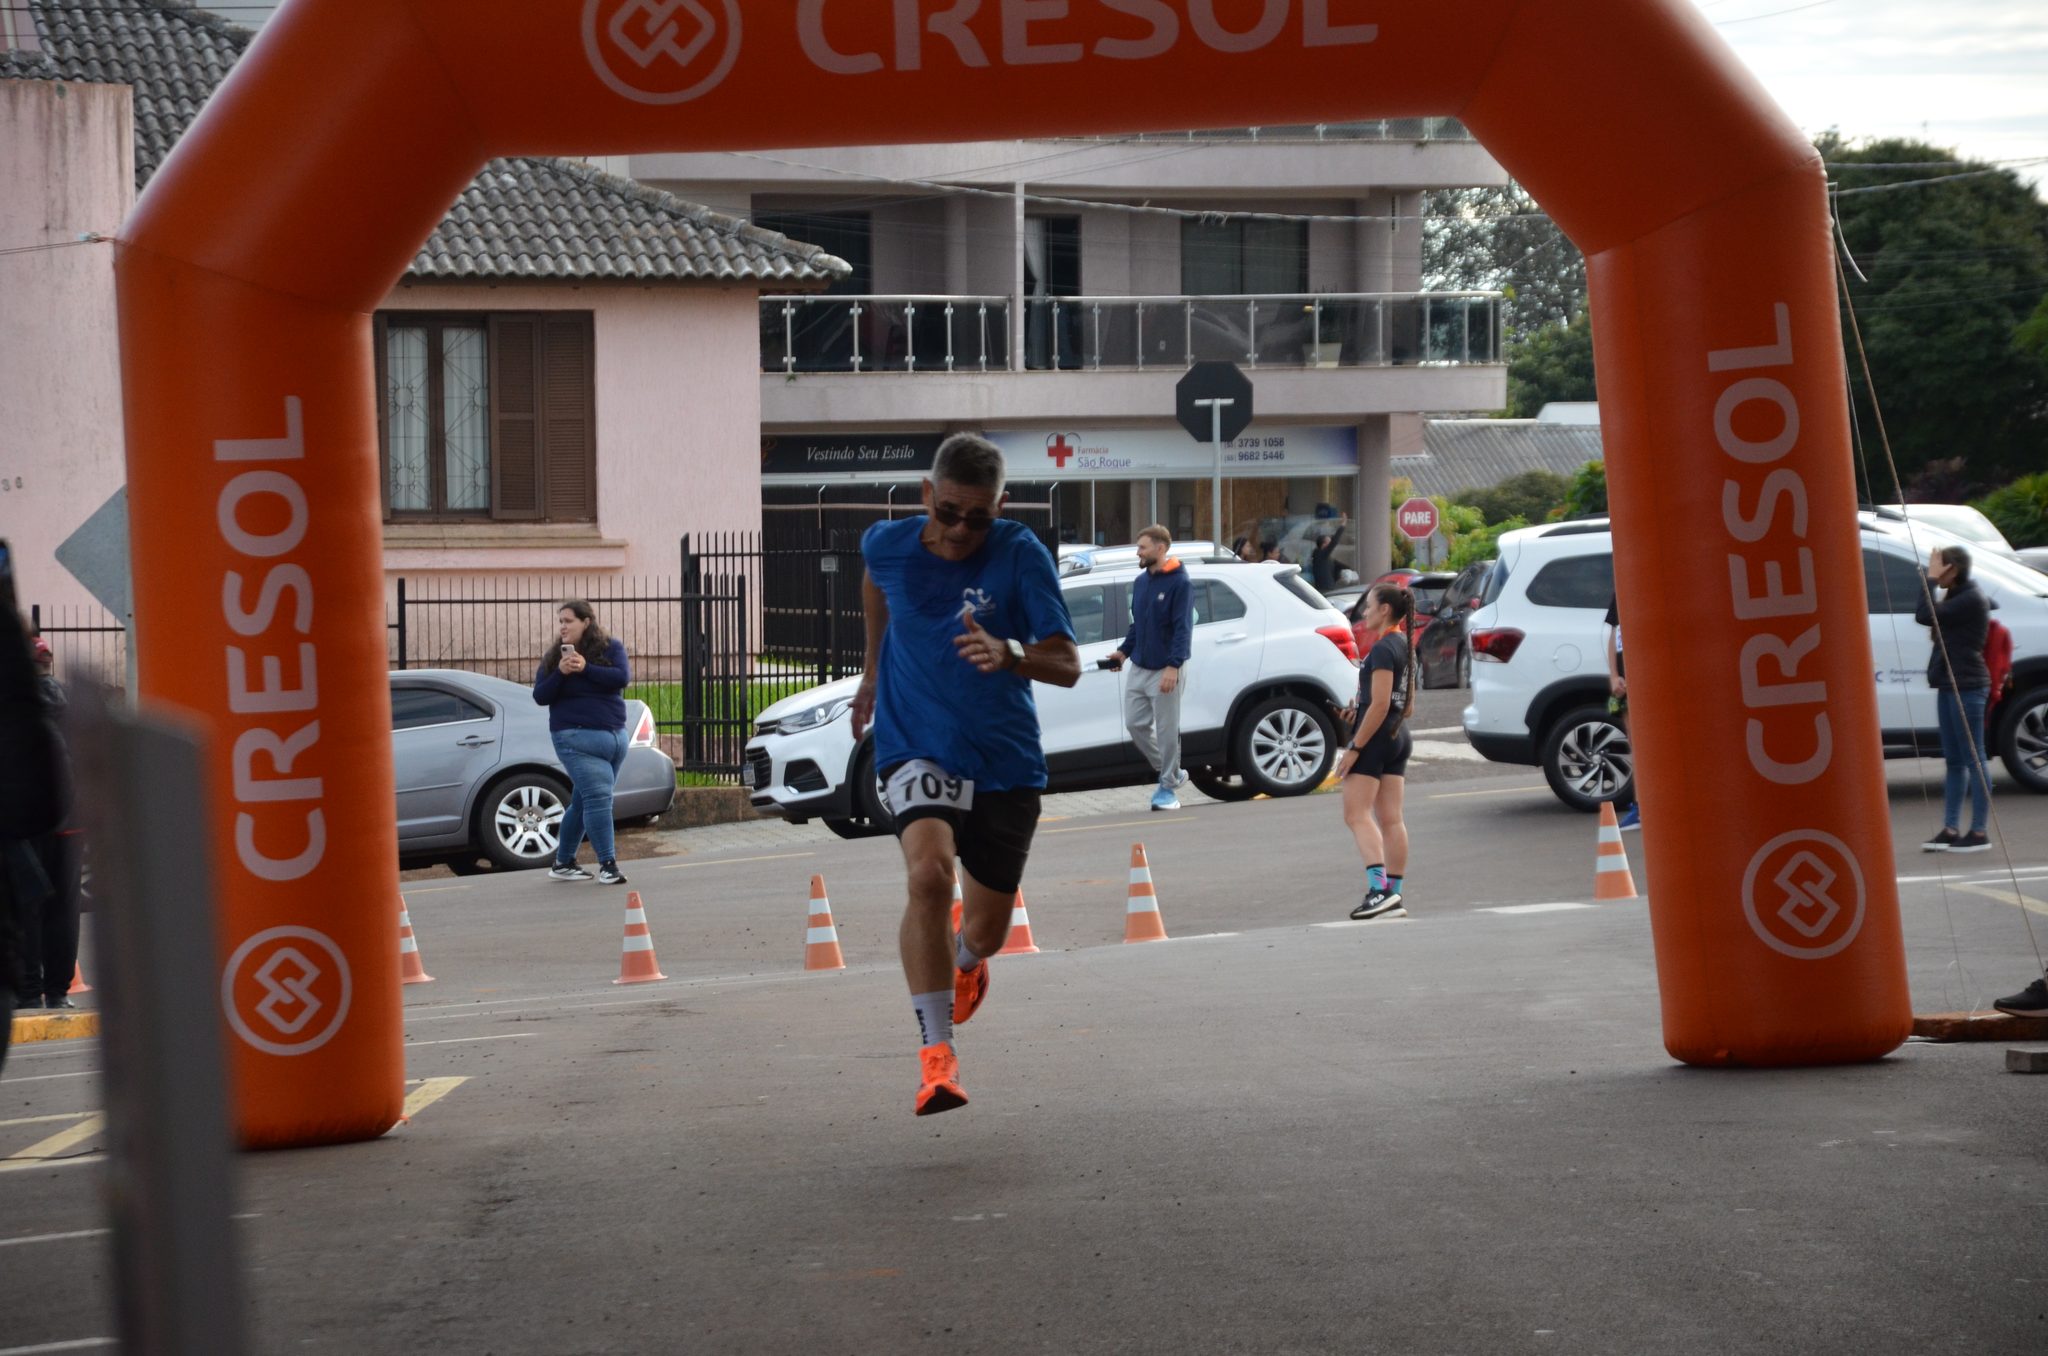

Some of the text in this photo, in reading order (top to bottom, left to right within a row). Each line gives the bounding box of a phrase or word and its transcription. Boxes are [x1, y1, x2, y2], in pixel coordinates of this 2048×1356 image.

[1238, 439, 1260, 448] 3739
[807, 444, 914, 461] Vestindo Seu Estilo
[1238, 451, 1260, 461] 9682
[1263, 450, 1285, 460] 5446
[1078, 457, 1096, 468] São
[1100, 457, 1131, 469] Roque
[1404, 511, 1431, 525] PARE
[1707, 302, 1833, 786] CRESOL
[213, 395, 327, 882] CRESOL
[901, 772, 963, 802] 709
